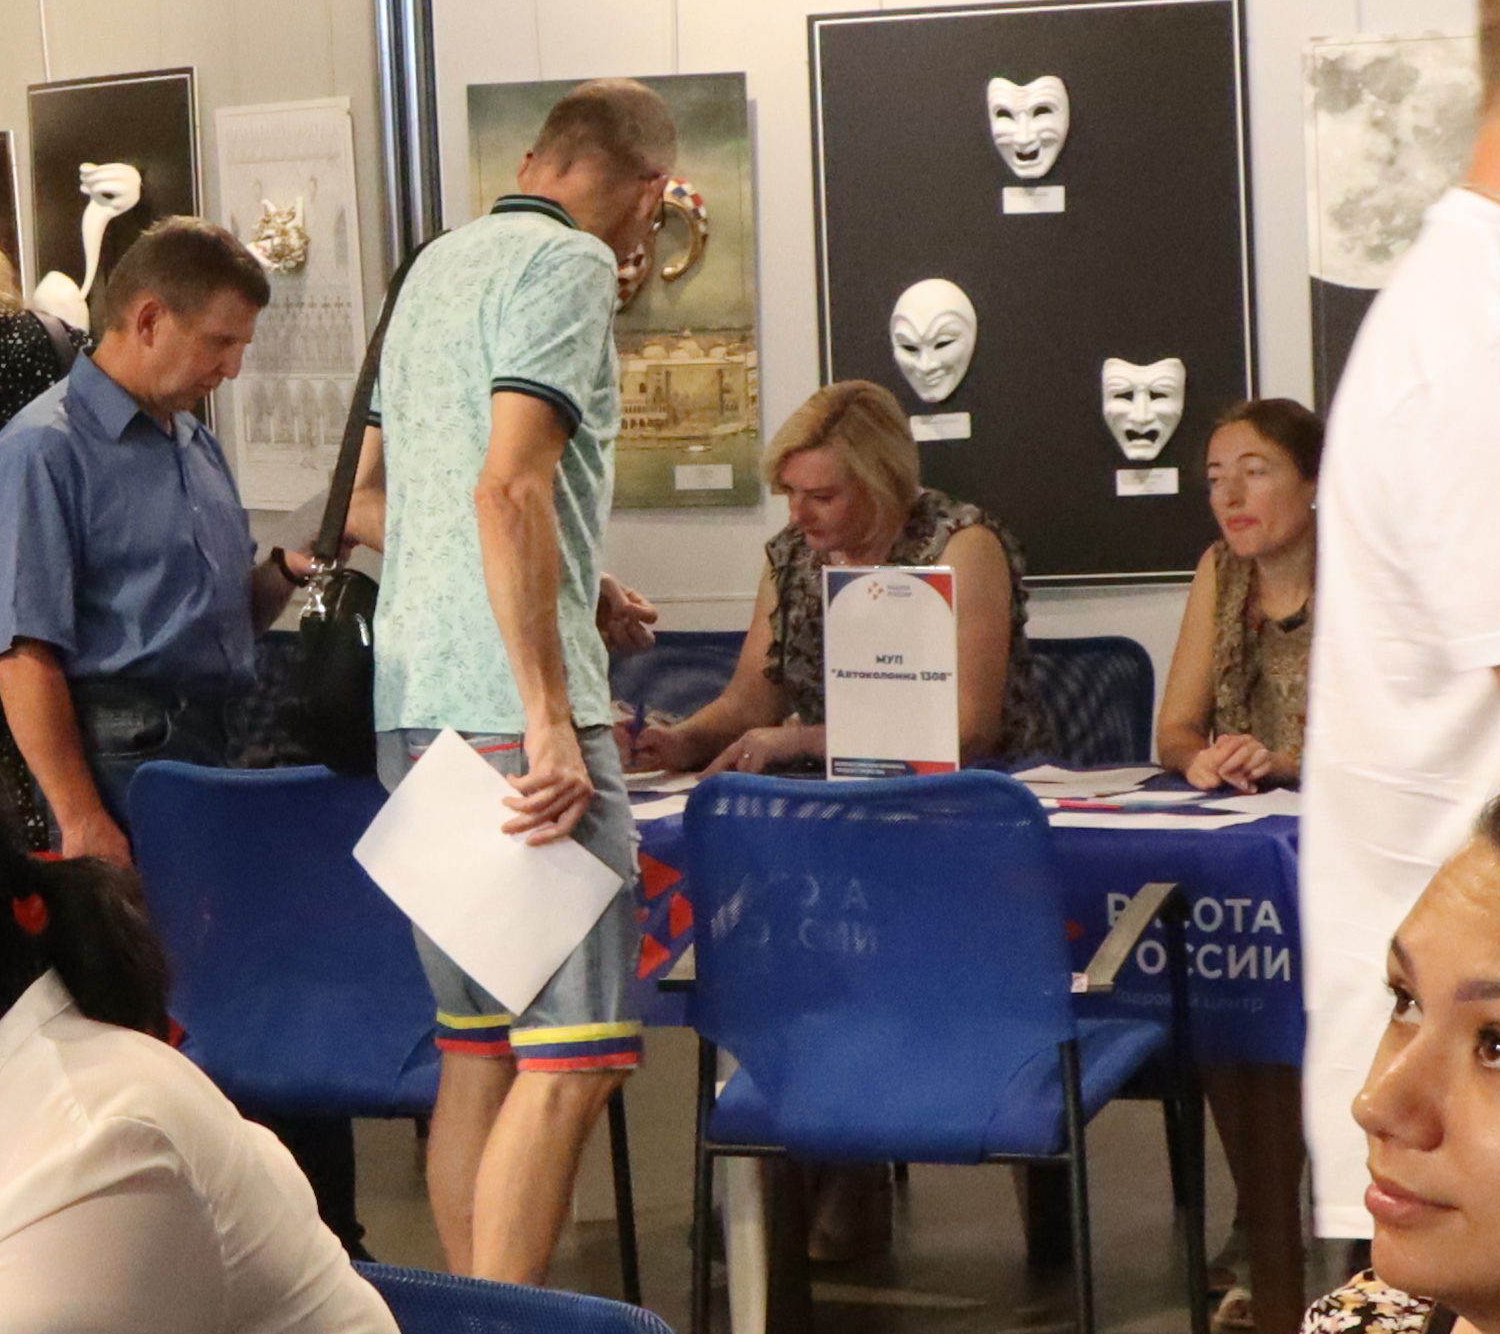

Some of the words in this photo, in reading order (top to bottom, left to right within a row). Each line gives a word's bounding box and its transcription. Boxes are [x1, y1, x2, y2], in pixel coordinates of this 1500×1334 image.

[875, 654, 904, 665] МУП
[1107, 892, 1284, 935] РОТА
[1135, 939, 1292, 982] ОСИИ
